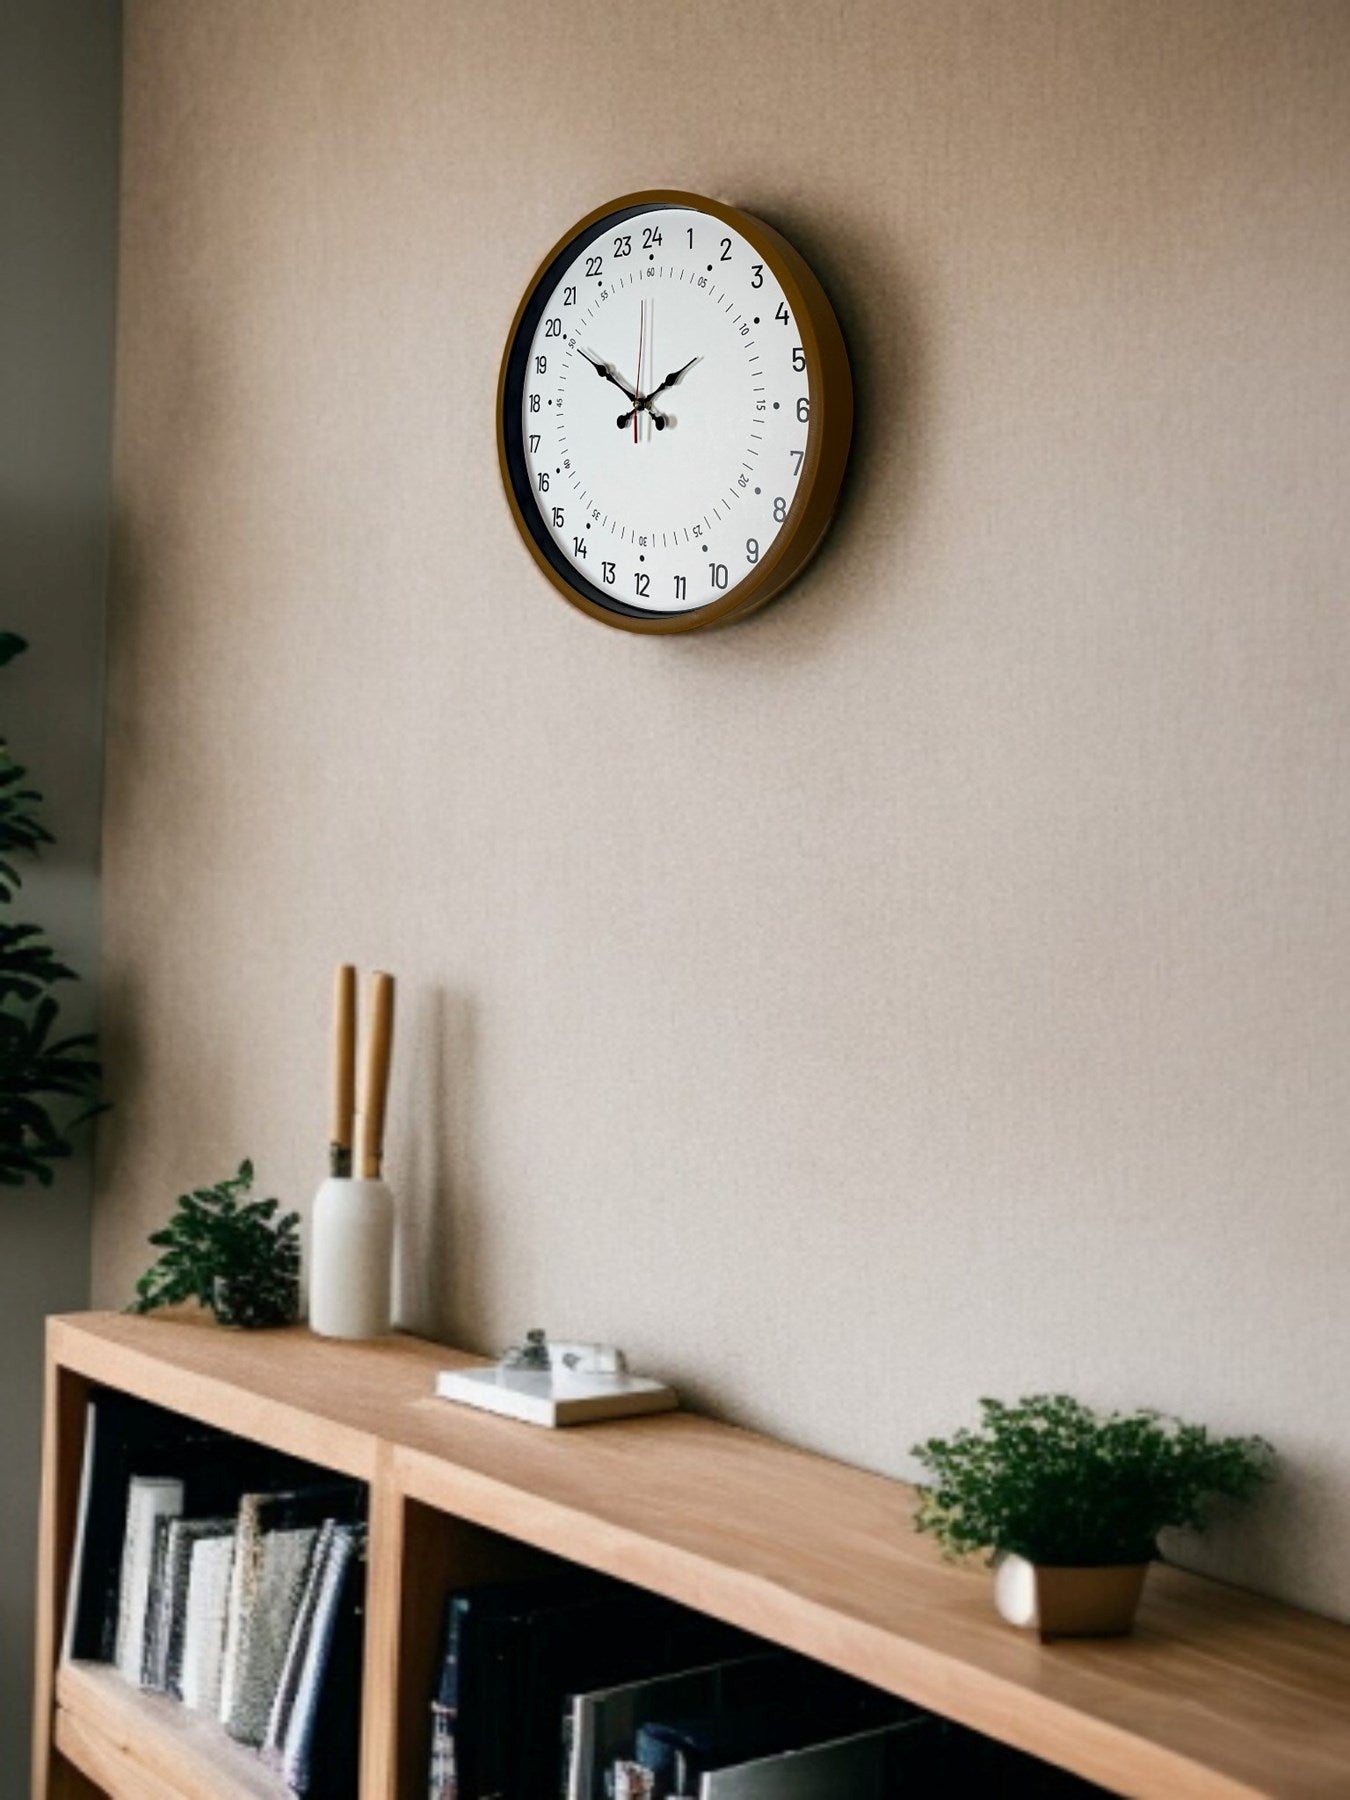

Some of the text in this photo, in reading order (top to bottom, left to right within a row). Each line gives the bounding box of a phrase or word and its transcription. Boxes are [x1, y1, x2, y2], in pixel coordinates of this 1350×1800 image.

[613, 236, 632, 258] 23
[642, 226, 663, 249] 24
[686, 228, 693, 249] 1
[720, 238, 732, 261] 2
[585, 256, 603, 277] 22
[646, 267, 655, 278] 60
[750, 264, 764, 289] 3
[697, 276, 708, 288] 05
[563, 286, 577, 306] 21
[600, 289, 609, 301] 55
[774, 301, 790, 326] 4
[545, 318, 562, 338] 20
[739, 323, 750, 336] 10
[567, 338, 577, 350] 50
[535, 356, 547, 375] 19
[792, 347, 806, 373] 5
[529, 394, 541, 413] 18
[556, 397, 563, 408] 45
[756, 400, 766, 411] 15
[796, 398, 810, 423] 6
[529, 435, 541, 454] 17
[790, 450, 805, 476] 7
[537, 472, 550, 493] 16
[737, 473, 750, 488] 20
[551, 506, 565, 528] 15
[773, 496, 787, 523] 8
[638, 535, 648, 547] 30
[692, 524, 703, 538] 25
[573, 536, 588, 559] 14
[745, 537, 760, 564] 9
[601, 561, 616, 585] 13
[708, 562, 729, 590] 10
[634, 572, 650, 598] 12
[673, 575, 687, 601] 11
